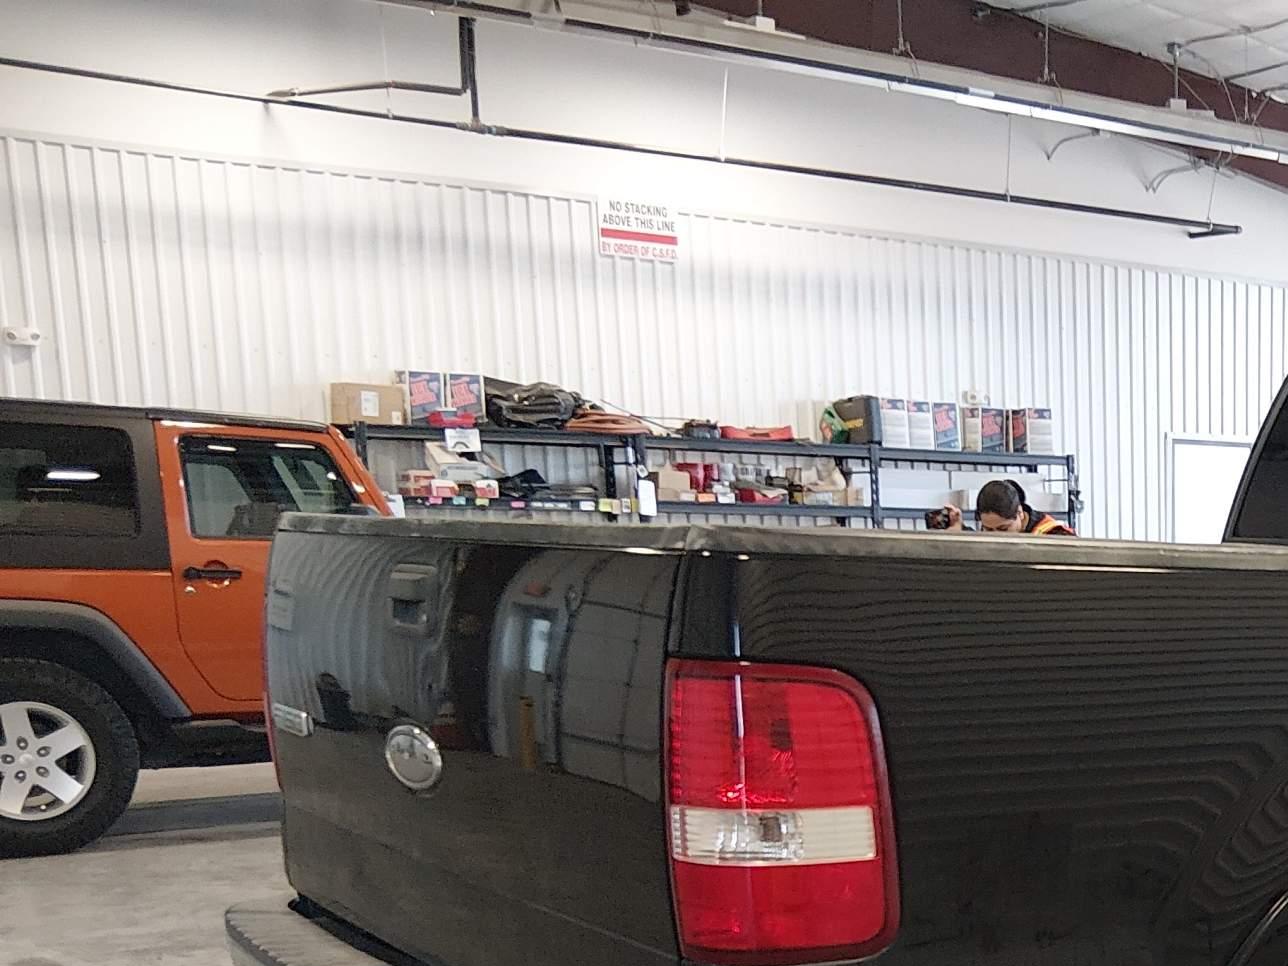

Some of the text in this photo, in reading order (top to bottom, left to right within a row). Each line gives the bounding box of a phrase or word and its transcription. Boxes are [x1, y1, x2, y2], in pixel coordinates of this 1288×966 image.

[608, 200, 668, 218] NO STACKING
[602, 213, 676, 232] ABOVE THIS LINE
[601, 241, 611, 253] BY
[613, 243, 638, 256] ORDER
[640, 246, 650, 257] OF
